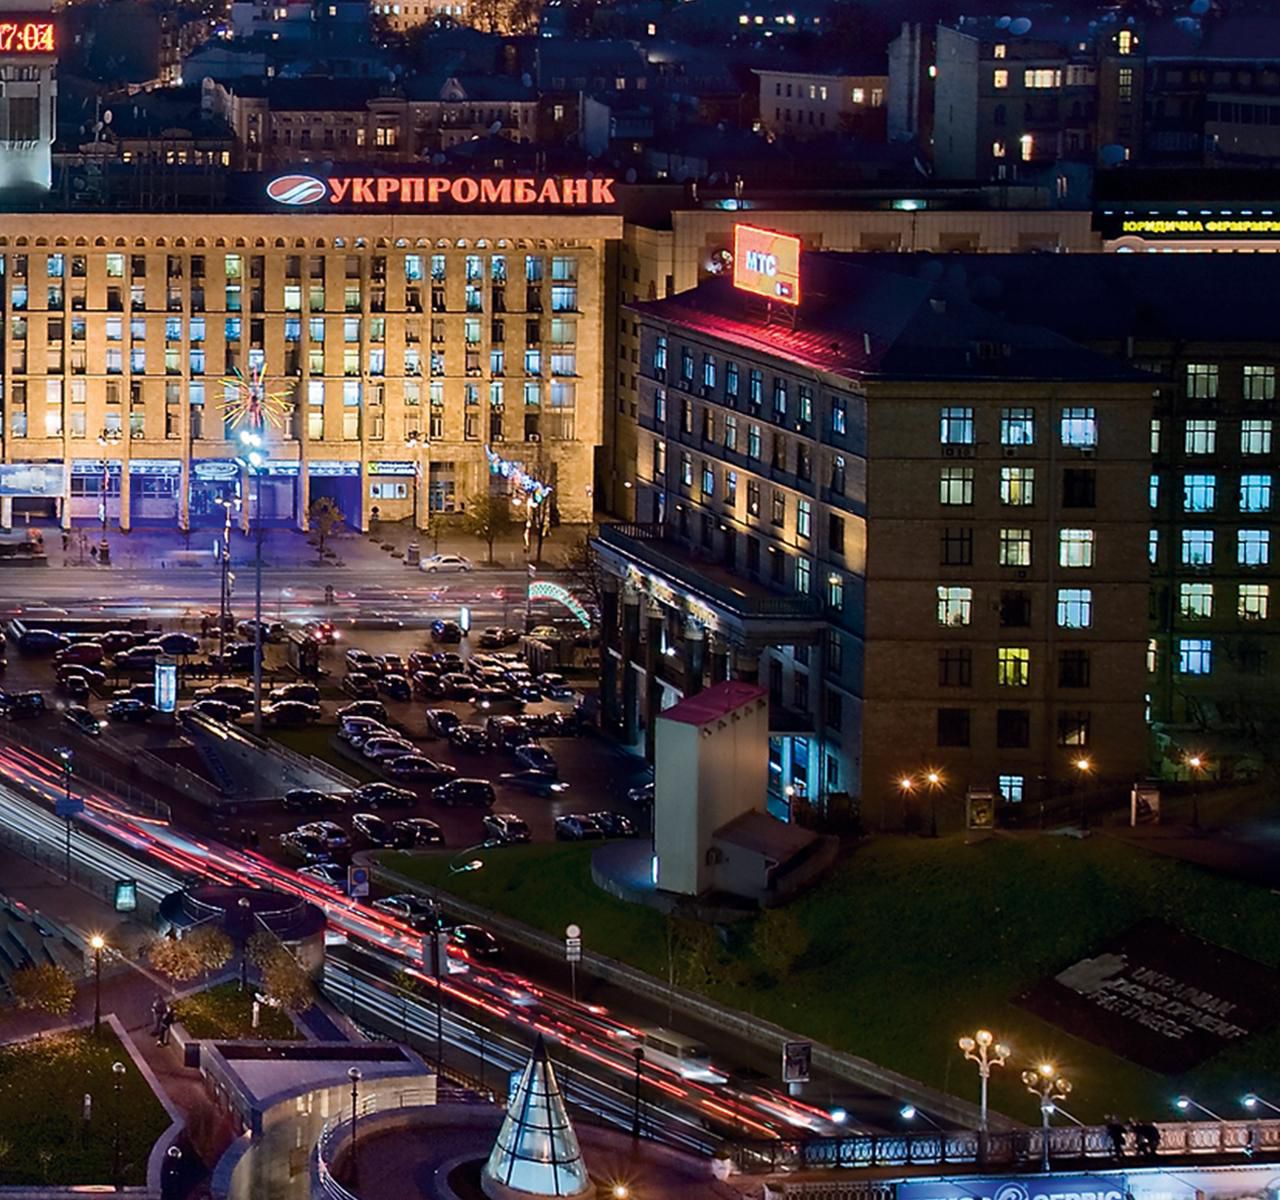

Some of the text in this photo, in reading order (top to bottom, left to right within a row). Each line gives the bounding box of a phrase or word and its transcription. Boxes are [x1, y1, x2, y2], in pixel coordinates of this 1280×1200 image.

[327, 177, 616, 205] УКРПРОМБАНК
[1088, 988, 1193, 1040] PARTNERS
[1107, 977, 1249, 1040] DEVELOPMENT
[1131, 966, 1238, 1018] UKRAINIAN
